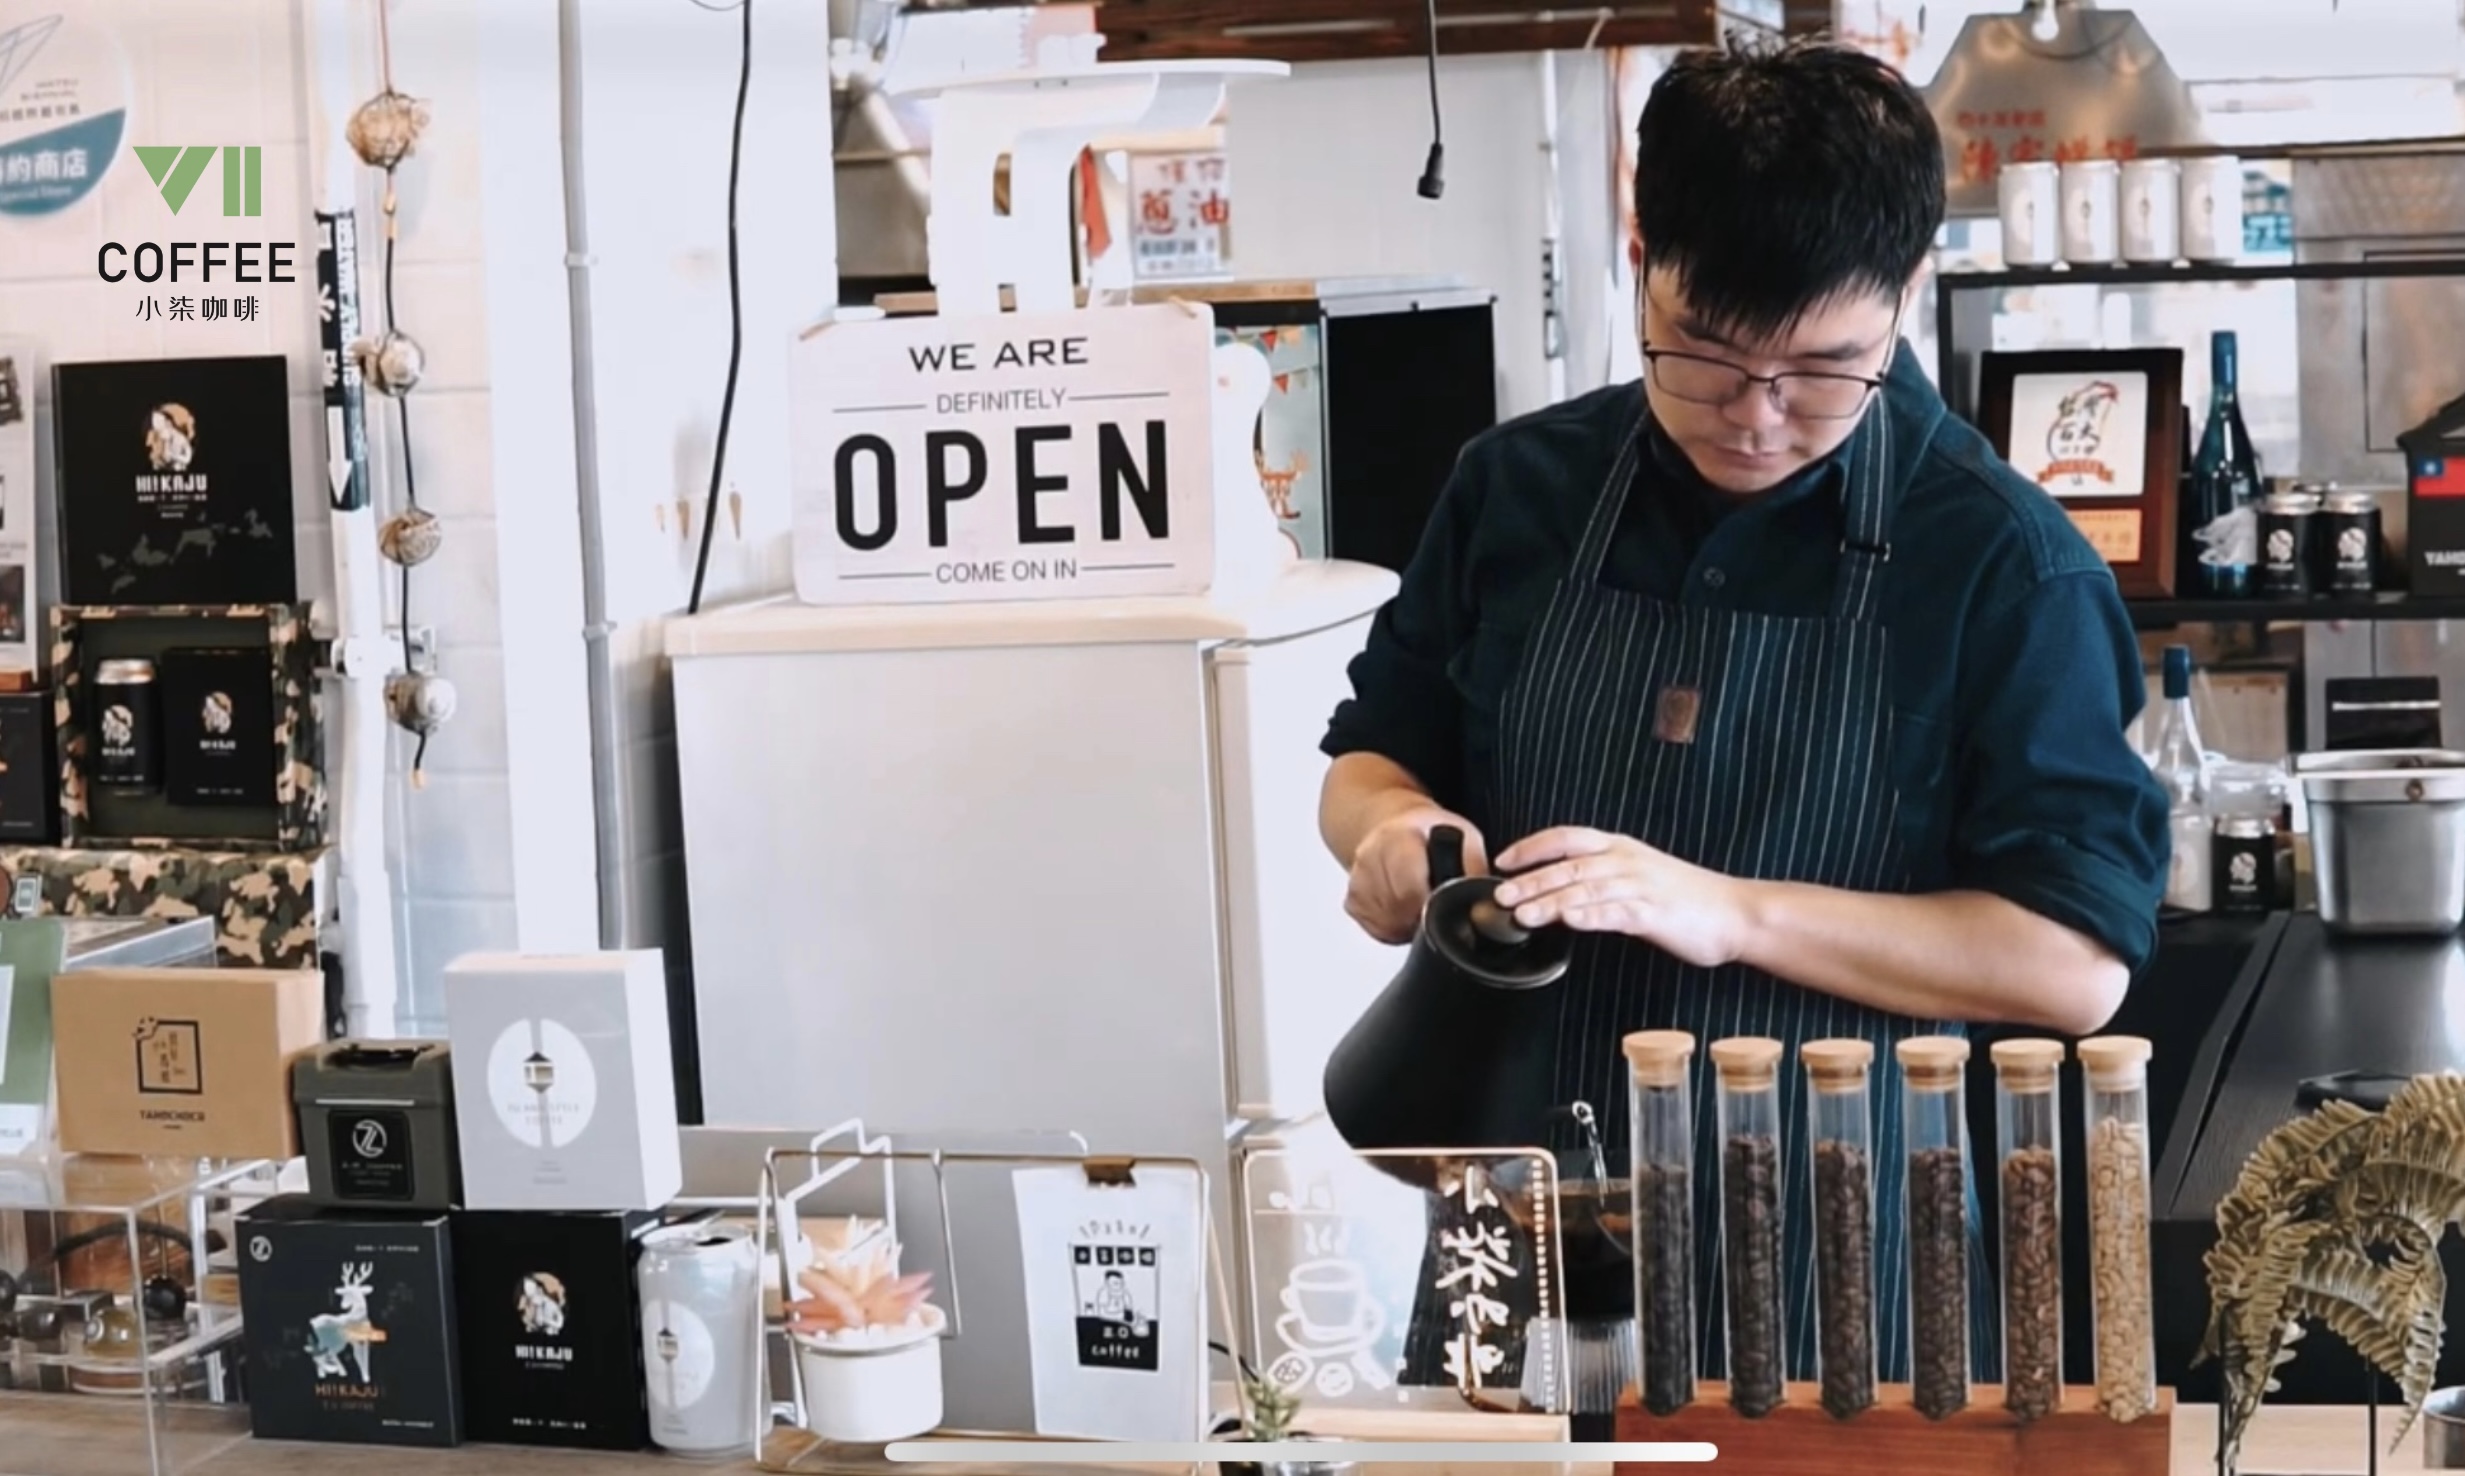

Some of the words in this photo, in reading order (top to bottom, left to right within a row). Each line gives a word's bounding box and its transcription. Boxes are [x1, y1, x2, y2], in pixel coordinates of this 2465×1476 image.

[0, 148, 88, 185] 約商店
[909, 344, 976, 372] WE
[994, 337, 1088, 367] ARE
[937, 388, 1066, 414] DEFINITELY
[834, 420, 1169, 551] OPEN
[936, 563, 1006, 584] COME
[1012, 561, 1047, 581] ON
[1055, 559, 1077, 579] IN
